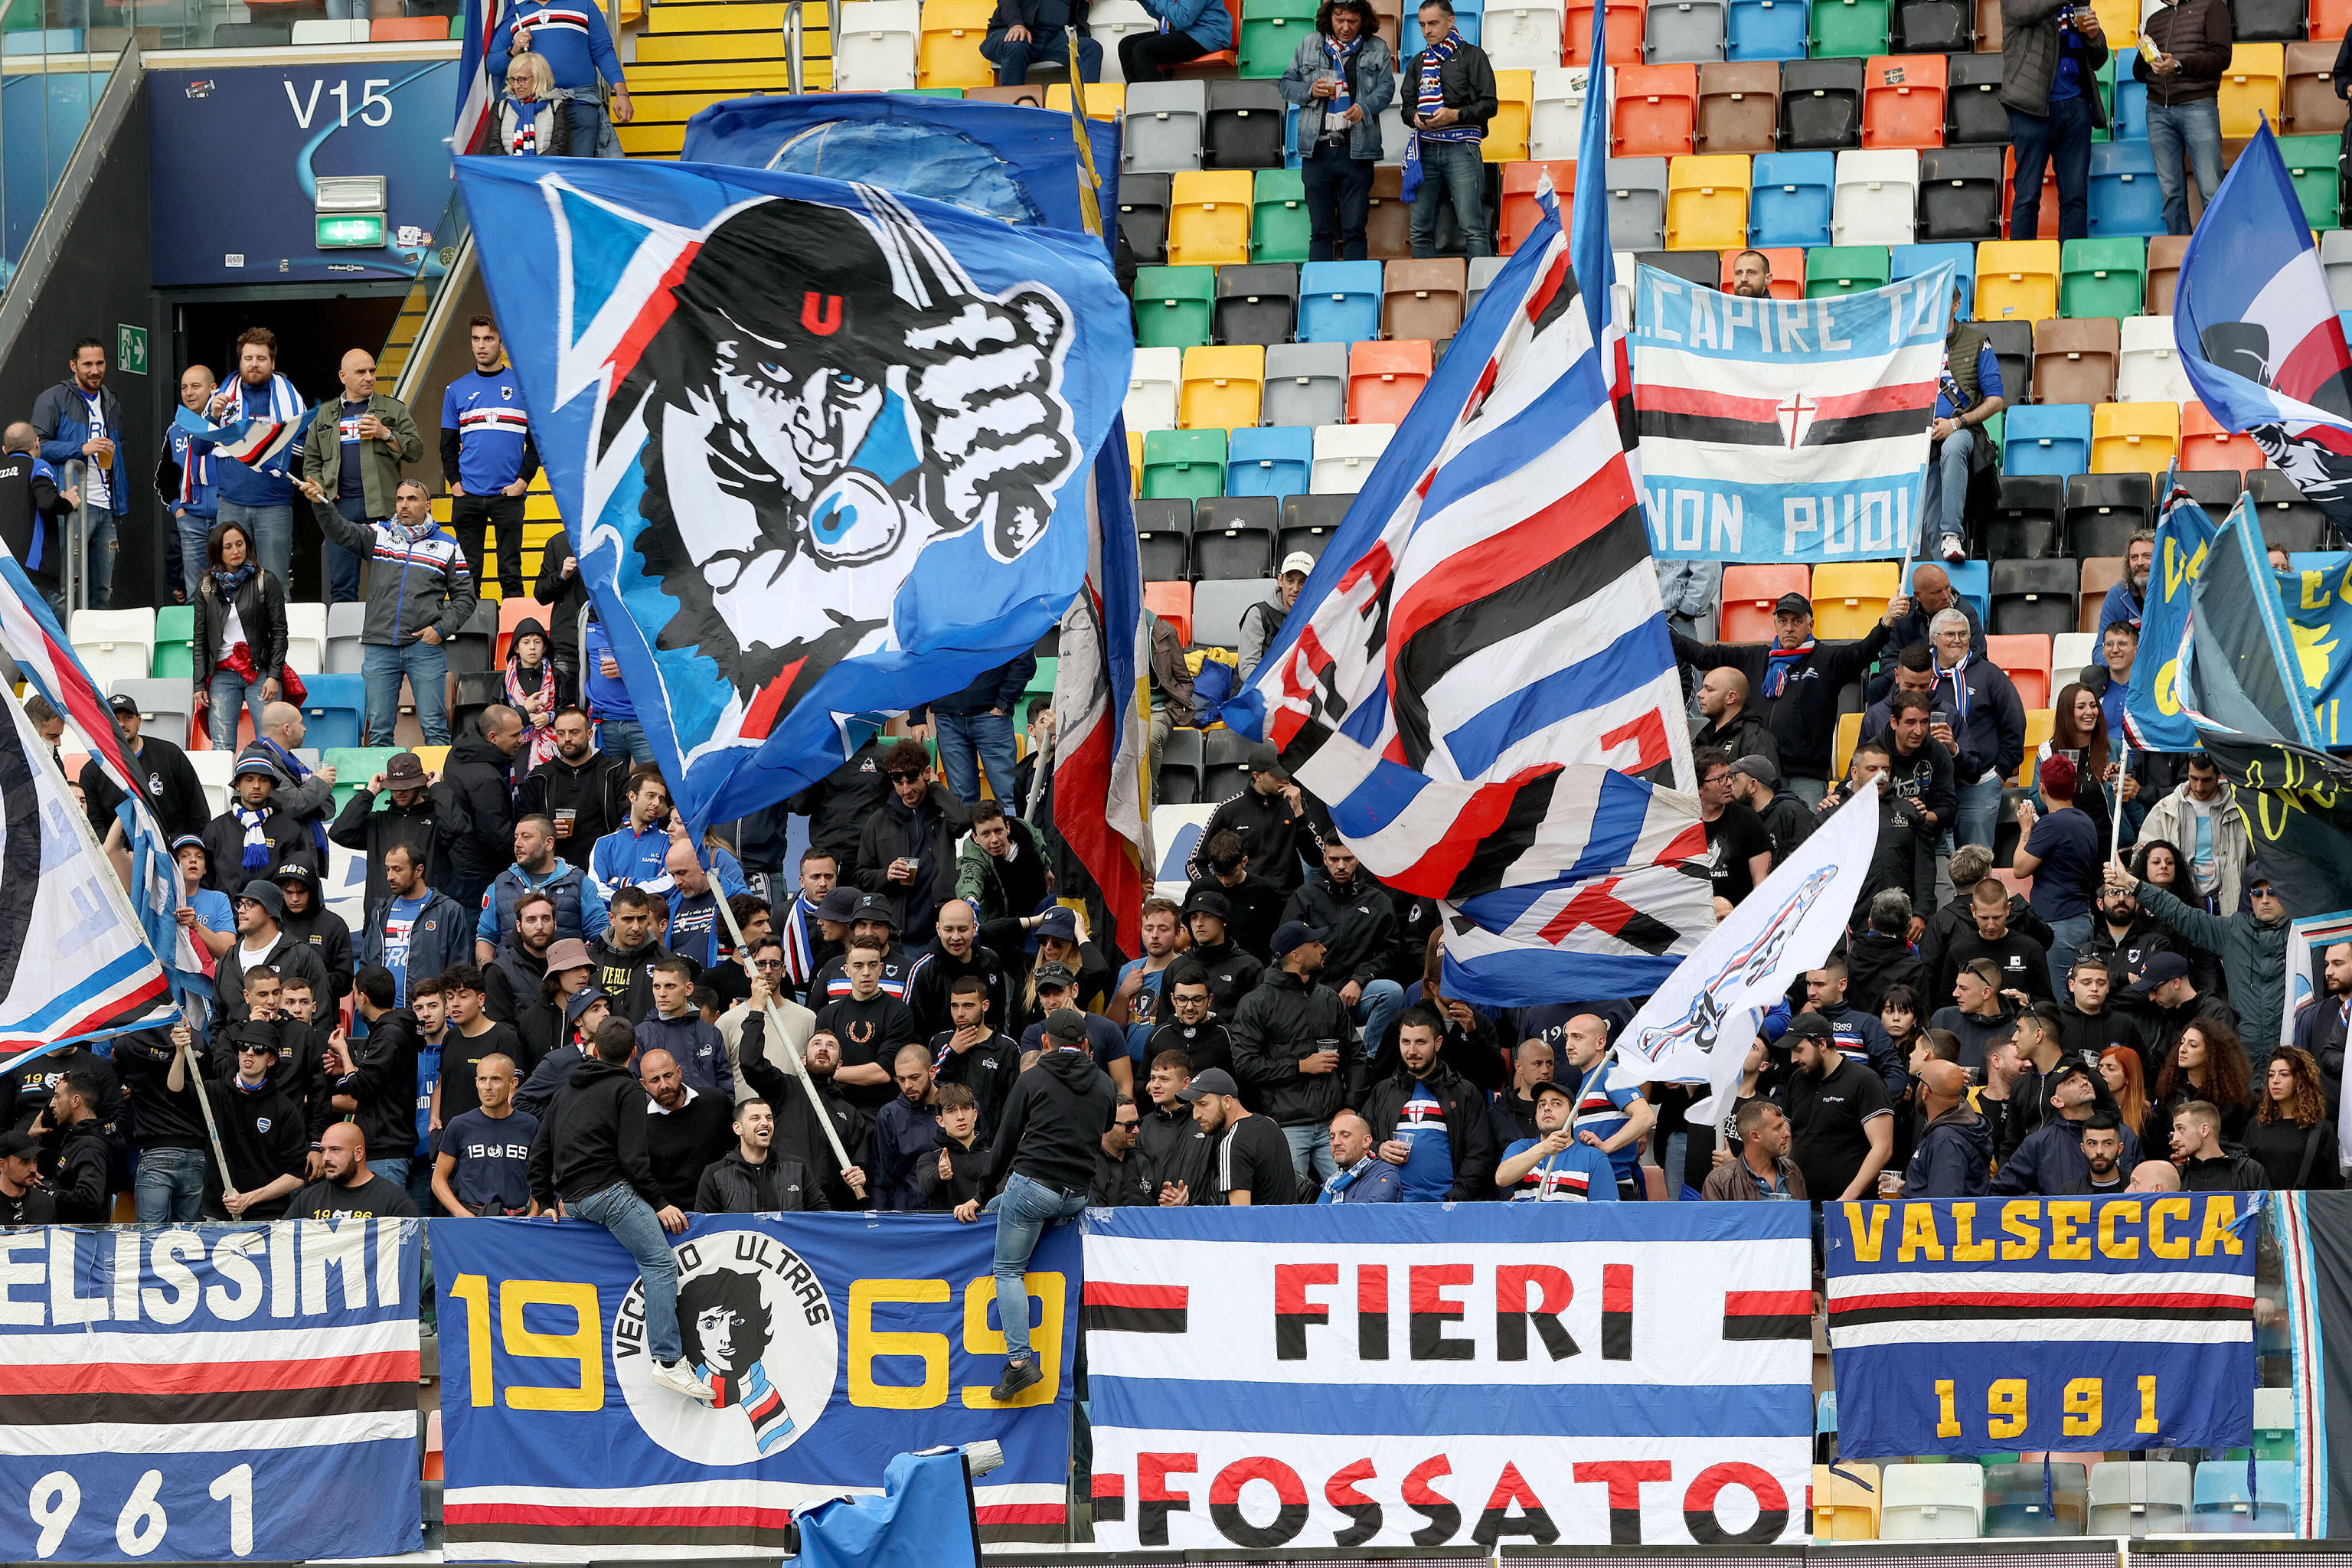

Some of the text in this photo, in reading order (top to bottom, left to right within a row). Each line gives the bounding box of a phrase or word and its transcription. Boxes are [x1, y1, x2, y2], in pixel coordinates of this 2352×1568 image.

[283, 78, 393, 129] V15
[1879, 271, 1948, 345] TU
[1645, 487, 1909, 556] NON PUOI
[1832, 1021, 1852, 1032] 1999
[467, 1143, 528, 1161] 19 69
[1844, 1195, 2244, 1263] VALSECCA
[735, 1234, 831, 1327] ULTRAS
[1275, 1263, 1634, 1362] FIERI
[1934, 1375, 2159, 1439] 1991
[1137, 1452, 1789, 1550] FOSSATO
